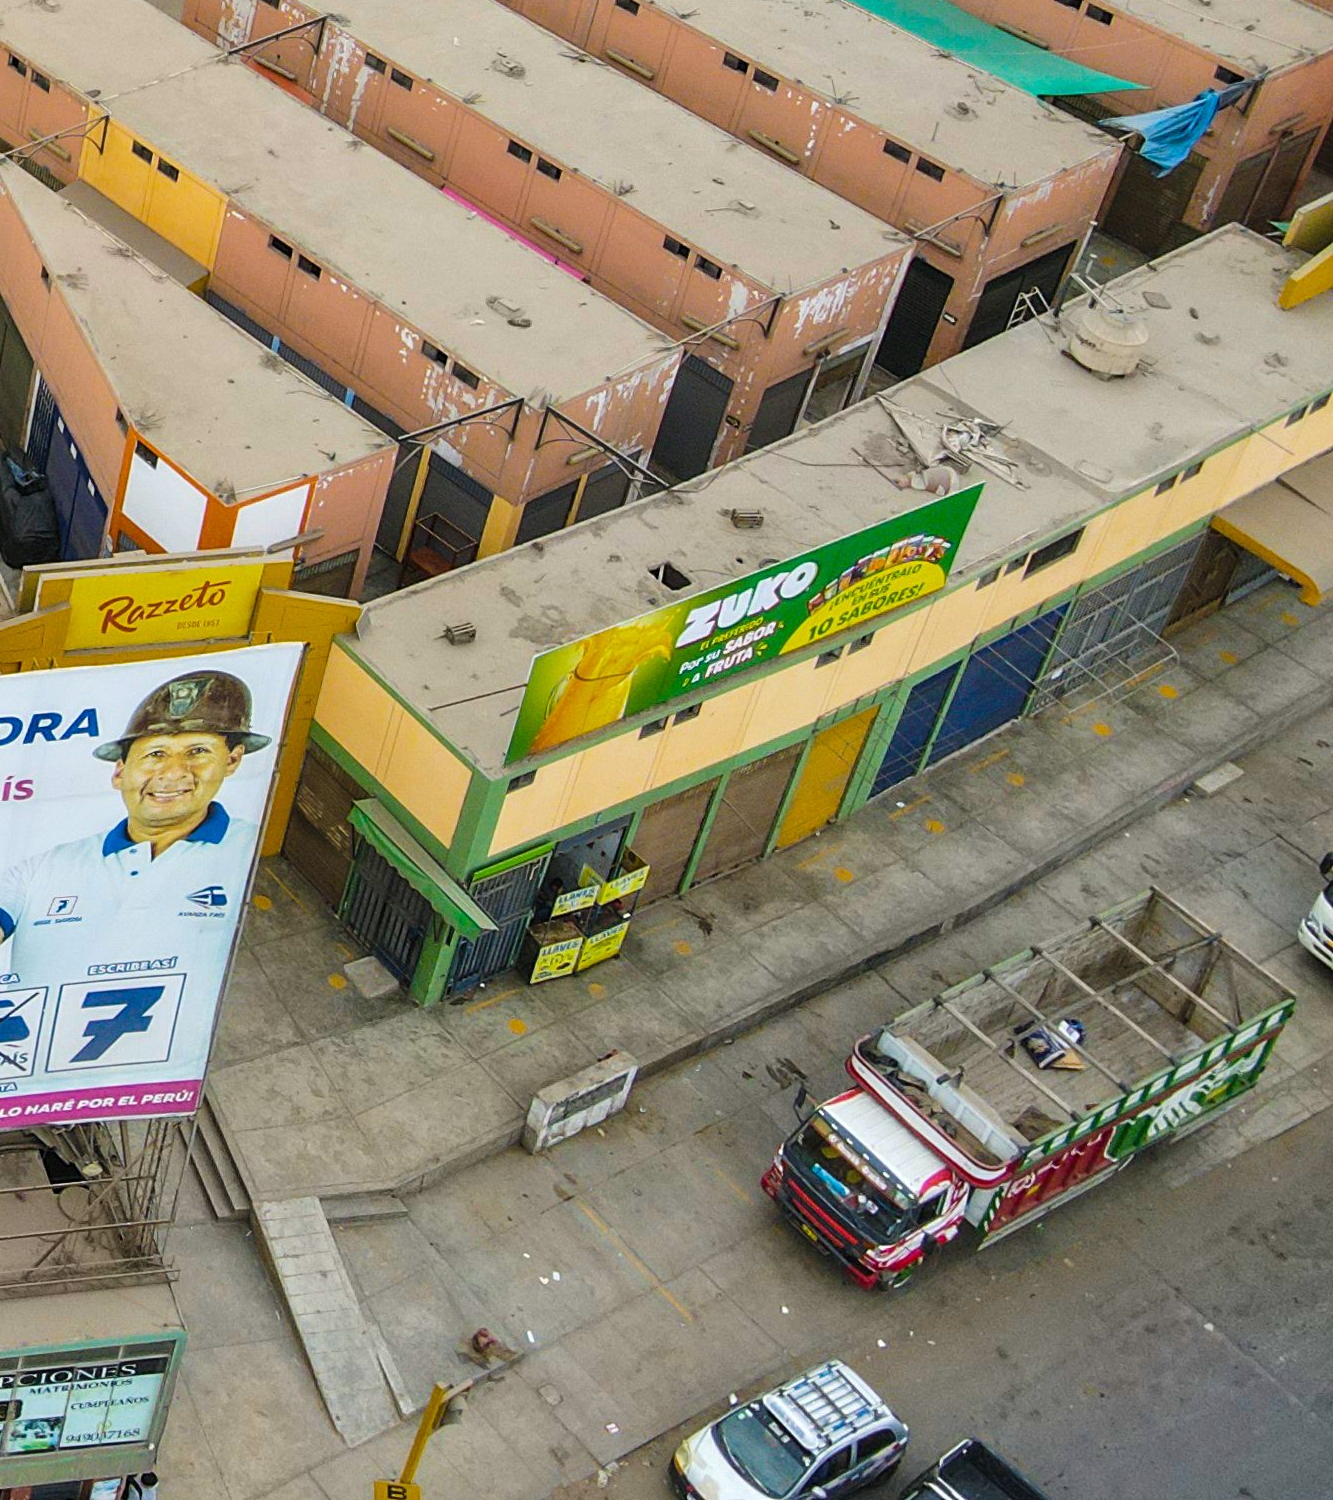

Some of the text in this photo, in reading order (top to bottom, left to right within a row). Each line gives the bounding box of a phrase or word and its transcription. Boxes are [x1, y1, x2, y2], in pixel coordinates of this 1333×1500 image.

[98, 580, 232, 633] Razzeto
[676, 562, 818, 650] ZUKO
[852, 583, 890, 606] EN SUS
[808, 583, 925, 642] 10 SABORES!
[678, 622, 776, 676] Por su SABOR
[704, 648, 754, 679] FRUTA
[88, 956, 178, 976] ESCRIBE ASÍ
[69, 985, 166, 1063] 7
[25, 1099, 74, 1116] HARÉ
[77, 1096, 114, 1110] POR
[118, 1094, 138, 1107] EL
[140, 1089, 193, 1106] PERÚ!
[30, 1378, 133, 1394] MATRIMONIOS
[70, 1395, 150, 1411] CUMPLEAÑOS
